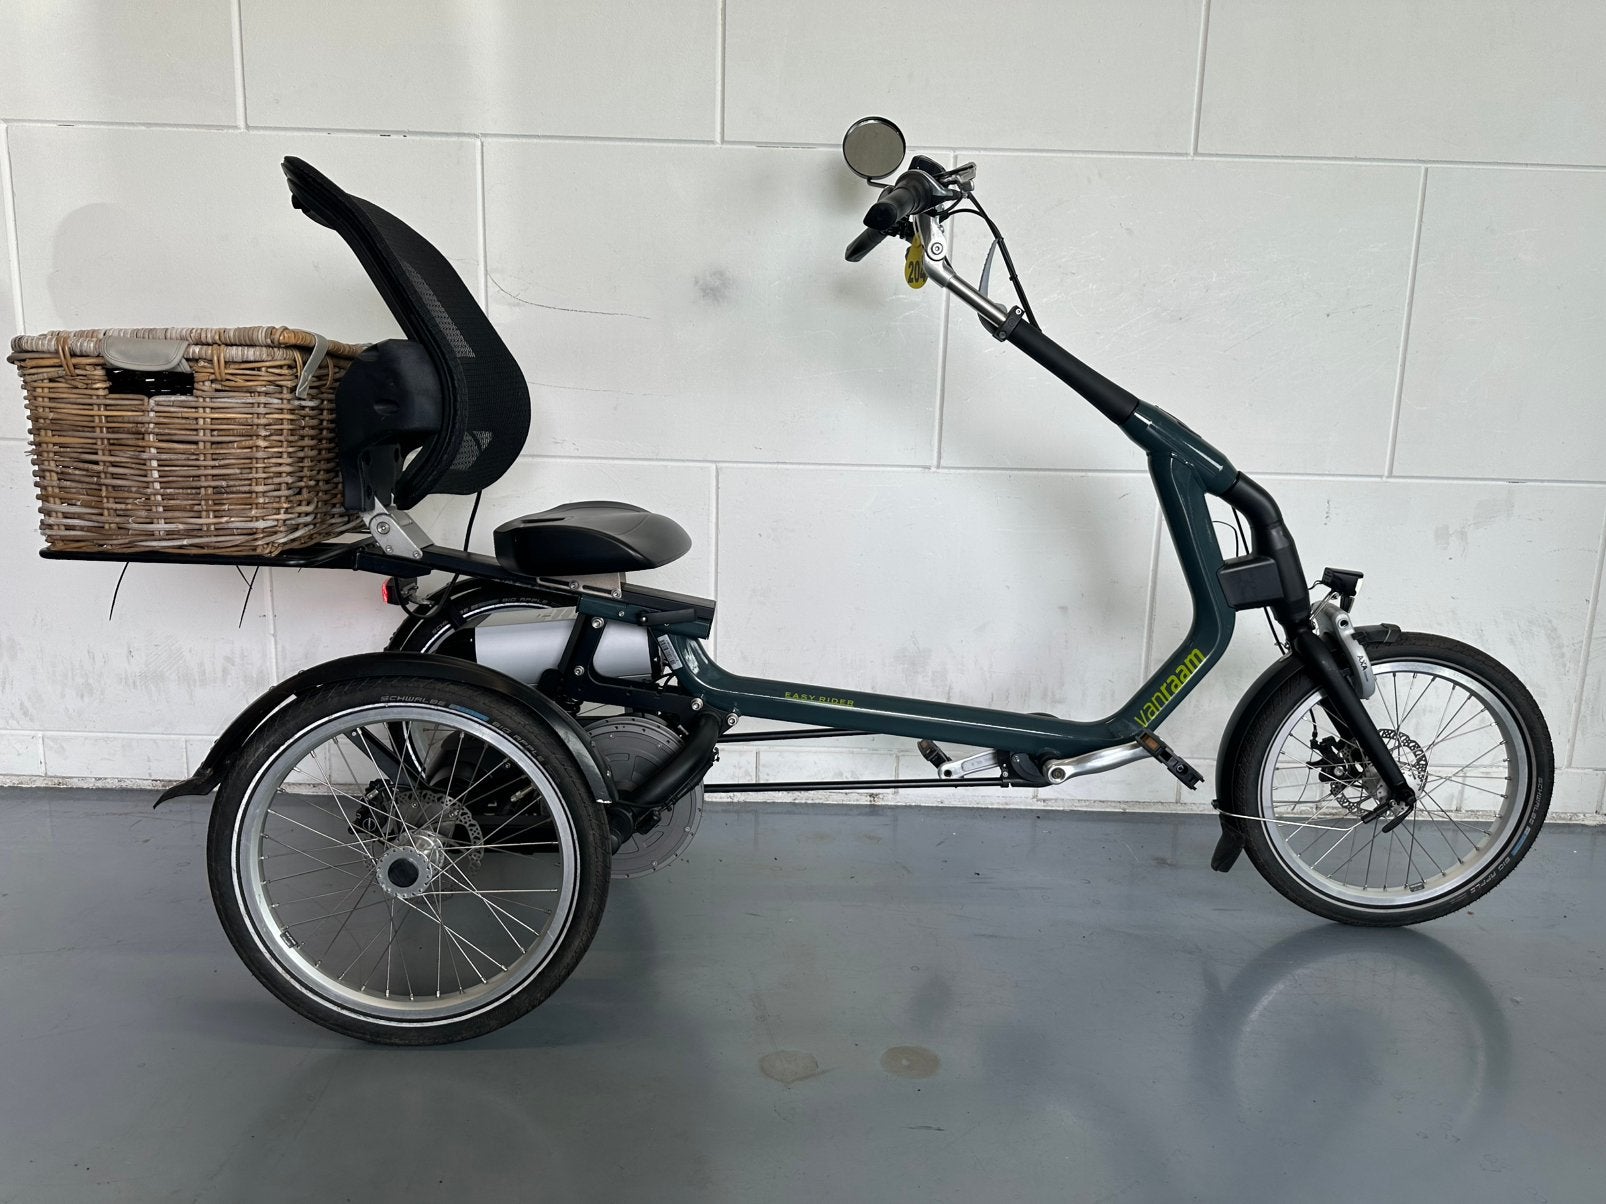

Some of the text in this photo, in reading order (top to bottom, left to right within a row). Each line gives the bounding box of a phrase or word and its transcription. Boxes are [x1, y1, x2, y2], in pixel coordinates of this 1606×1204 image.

[1357, 655, 1368, 671] AXA
[1134, 648, 1207, 728] vanraam
[380, 695, 447, 707] SCHWALBE
[784, 691, 854, 707] EASY RIDER
